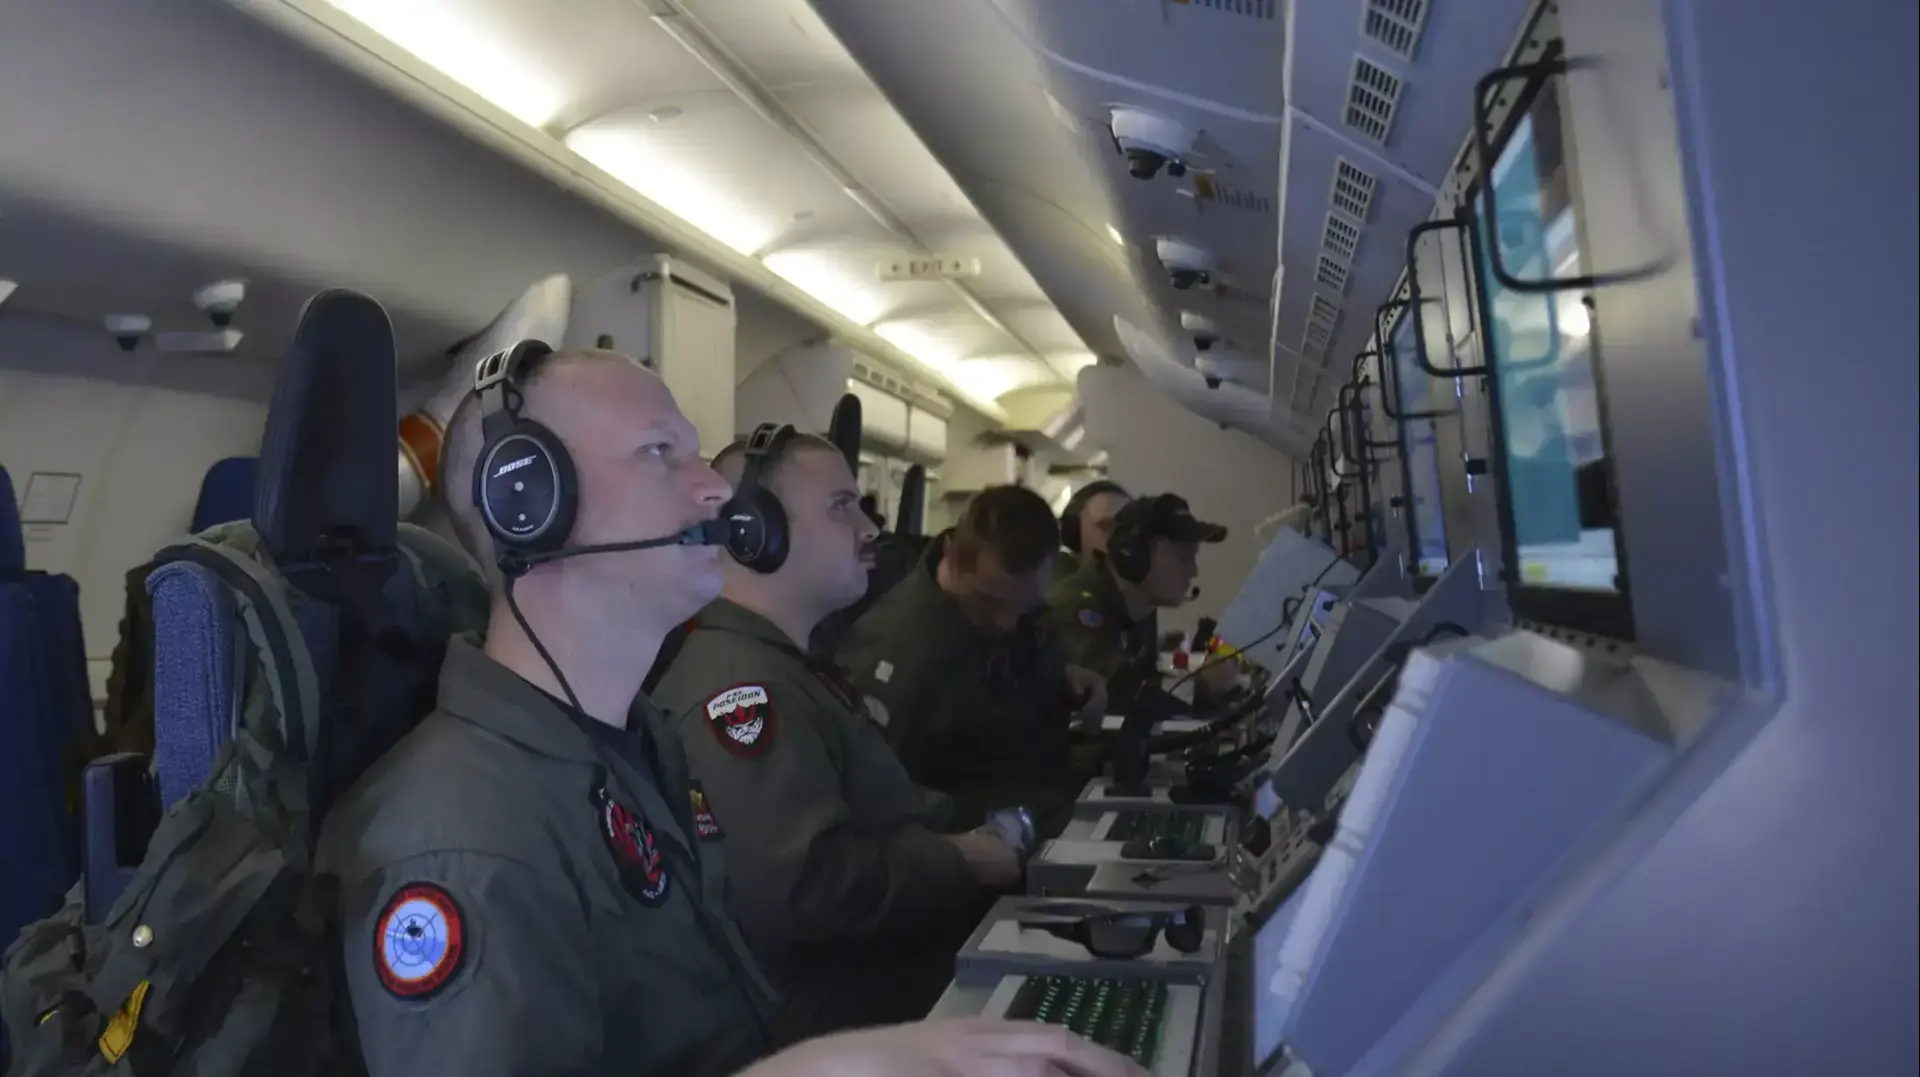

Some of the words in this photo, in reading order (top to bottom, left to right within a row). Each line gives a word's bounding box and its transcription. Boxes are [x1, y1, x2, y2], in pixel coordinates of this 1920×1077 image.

[909, 259, 943, 274] EXIT
[493, 455, 537, 478] BOSE
[713, 690, 762, 711] POSEIDON
